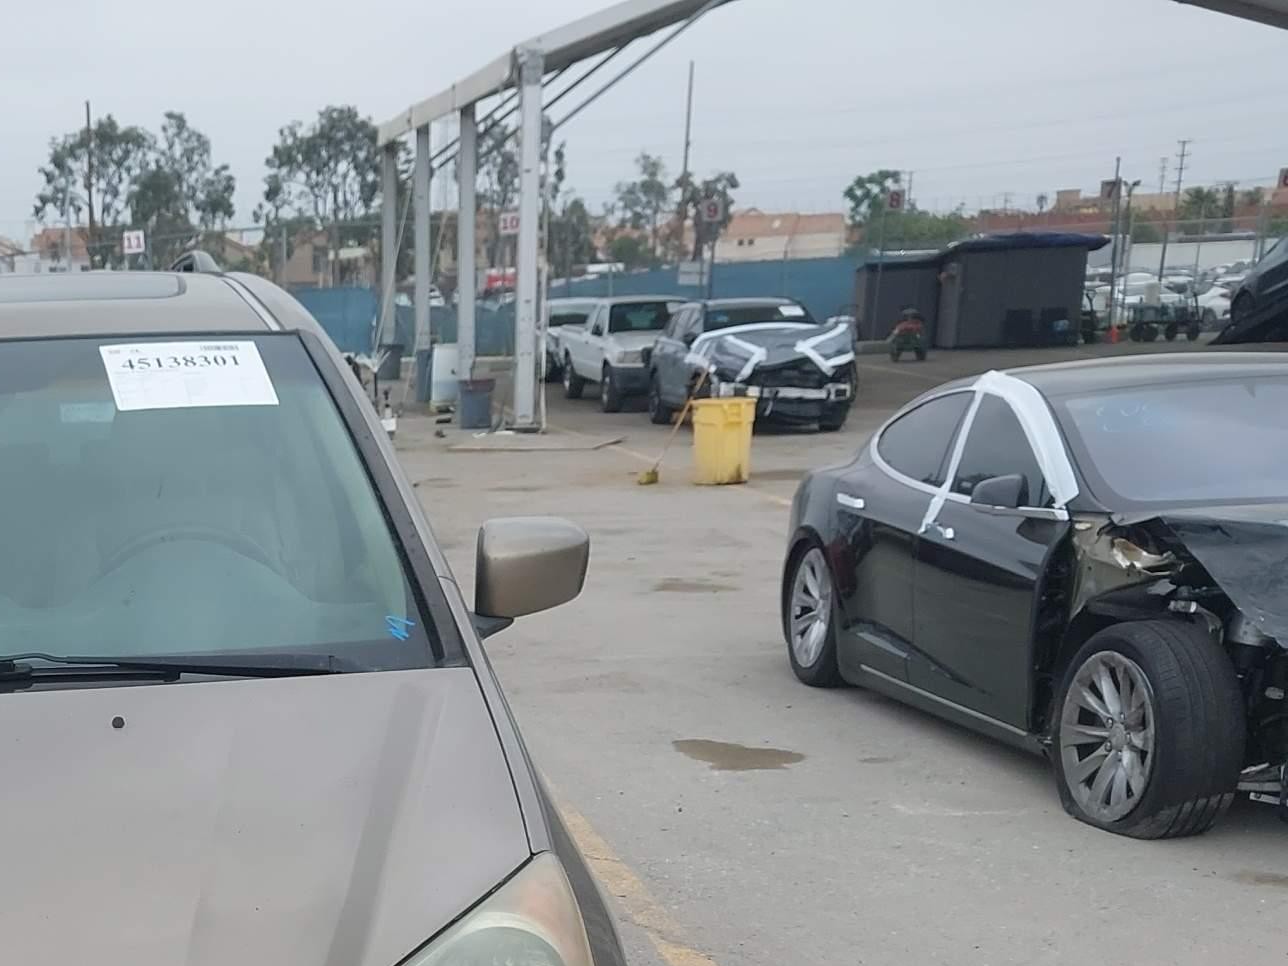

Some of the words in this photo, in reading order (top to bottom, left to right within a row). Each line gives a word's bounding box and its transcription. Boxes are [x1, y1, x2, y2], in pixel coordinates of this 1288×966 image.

[889, 192, 900, 207] 8
[707, 203, 718, 216] 9
[502, 217, 519, 228] 10
[126, 236, 142, 249] 11
[120, 355, 239, 369] 45138301
